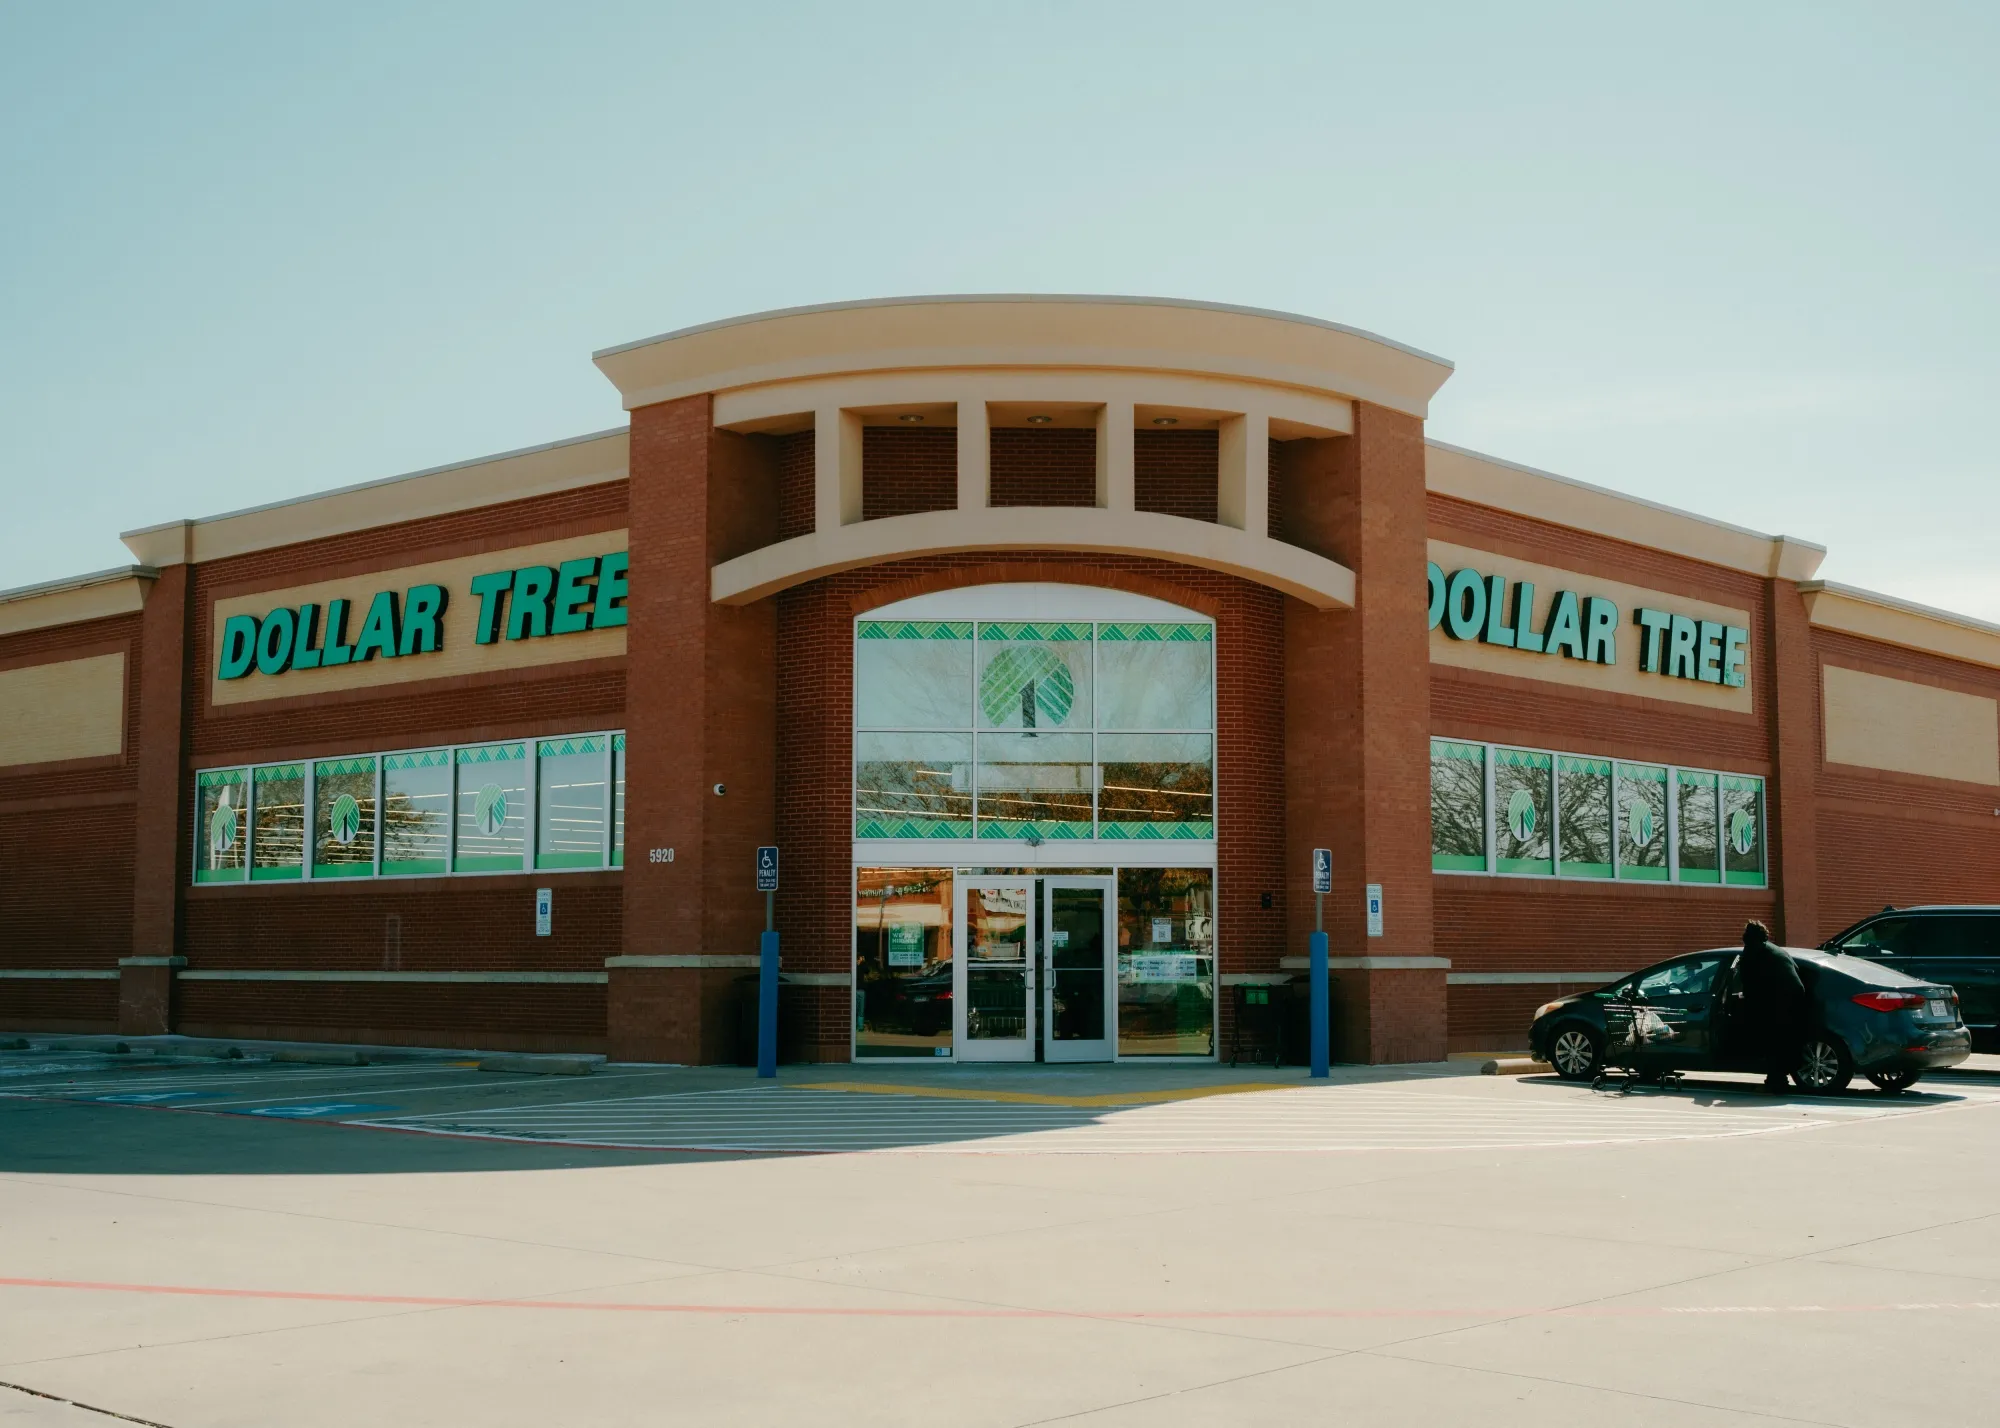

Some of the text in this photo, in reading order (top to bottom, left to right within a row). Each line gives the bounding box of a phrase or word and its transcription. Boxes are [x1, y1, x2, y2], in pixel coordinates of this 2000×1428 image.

[218, 551, 629, 680] DOLLAR TREE
[1636, 607, 1748, 688] TREE
[649, 848, 675, 862] 5920
[759, 869, 776, 877] PENALTY
